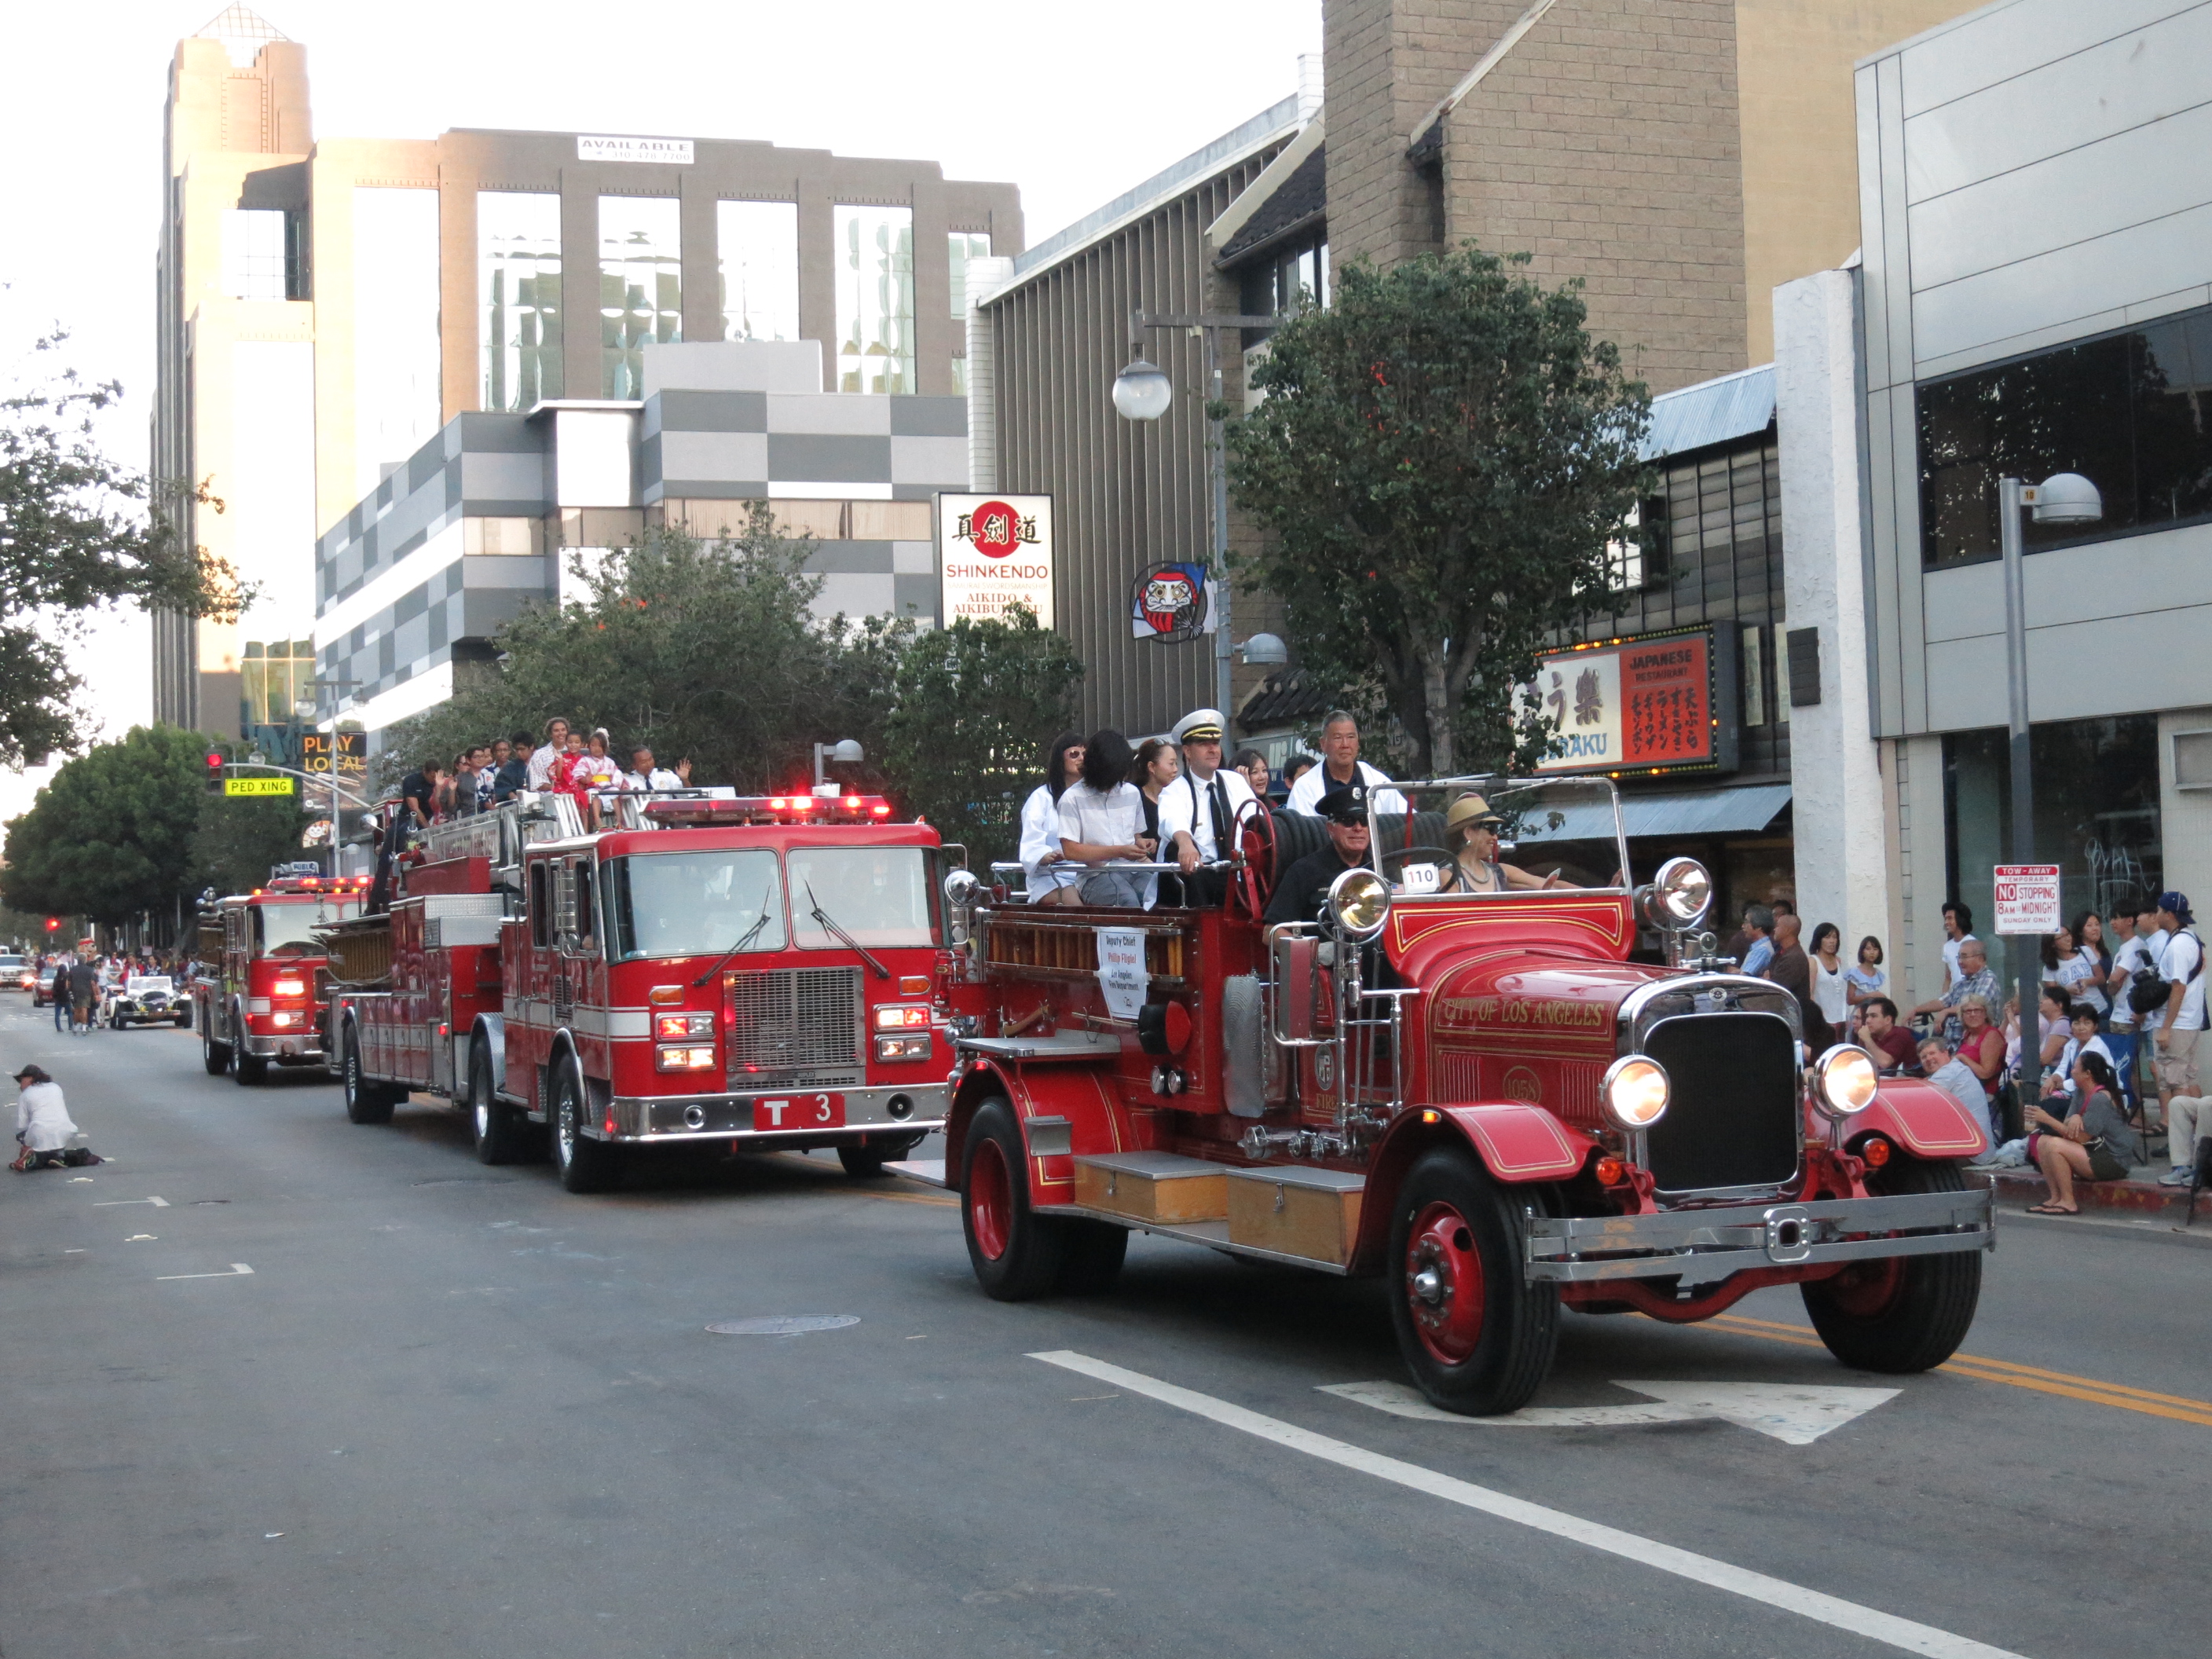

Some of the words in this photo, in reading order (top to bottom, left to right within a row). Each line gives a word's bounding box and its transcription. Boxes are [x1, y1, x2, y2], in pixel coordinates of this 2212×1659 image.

[582, 140, 689, 151] AVAILABLE
[947, 565, 1048, 579] SHINKENDO
[967, 593, 1017, 602] AIKIDO
[1024, 594, 1033, 602] &
[953, 604, 1043, 616] AIKIBUJSU
[1630, 649, 1692, 669] JAPANESE
[1636, 667, 1688, 682] RESTAURANT
[304, 735, 353, 753] PLAY
[305, 756, 364, 772] LOCAL
[232, 782, 255, 792] PED
[261, 782, 287, 792] XING
[1408, 870, 1433, 883] 110
[1998, 885, 2016, 900] NO
[2019, 888, 2055, 899] STOPPING
[1998, 903, 2016, 914] 8AM
[2022, 902, 2056, 914] MIDNIGHT
[1106, 936, 1122, 947] Deputy
[1123, 936, 1136, 947] Chief
[2060, 964, 2090, 985] GAP
[1445, 998, 1477, 1020] CITY
[1478, 999, 1498, 1021] OF
[1501, 1000, 1531, 1023] LOS
[1533, 1002, 1605, 1027] ANGELES
[1507, 1079, 1536, 1101] 1058
[764, 1101, 789, 1126] T
[816, 1093, 831, 1122] 3
